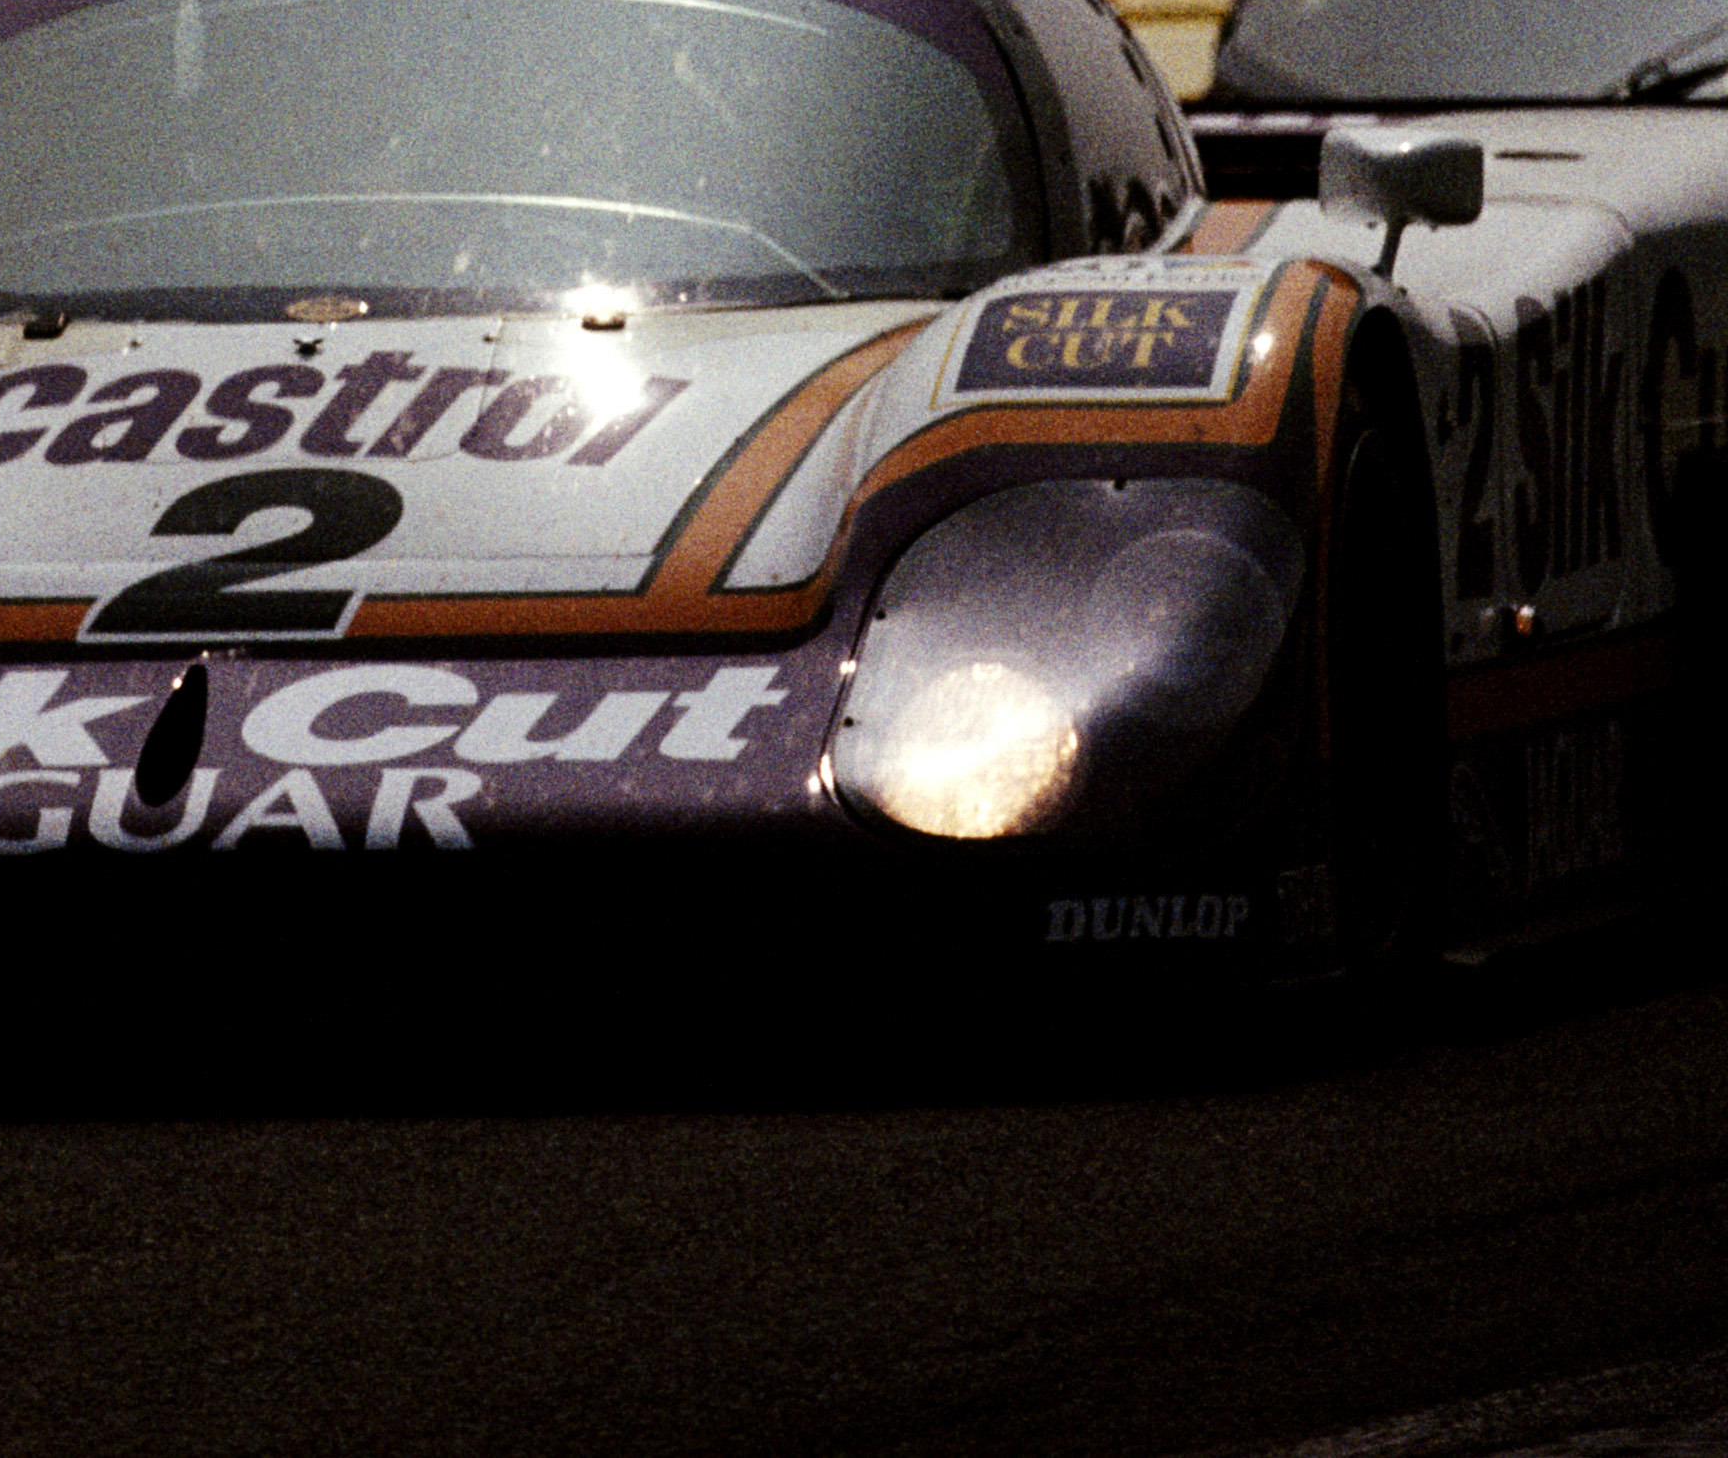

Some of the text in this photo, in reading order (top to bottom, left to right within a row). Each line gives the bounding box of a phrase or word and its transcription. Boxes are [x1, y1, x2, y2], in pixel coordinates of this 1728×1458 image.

[1001, 297, 1199, 331] SILK
[1005, 333, 1178, 371] CUT
[1515, 277, 1624, 596] Silk
[84, 468, 406, 637] 2
[241, 663, 790, 767] Cut
[1044, 892, 1251, 943] DUNLOP
